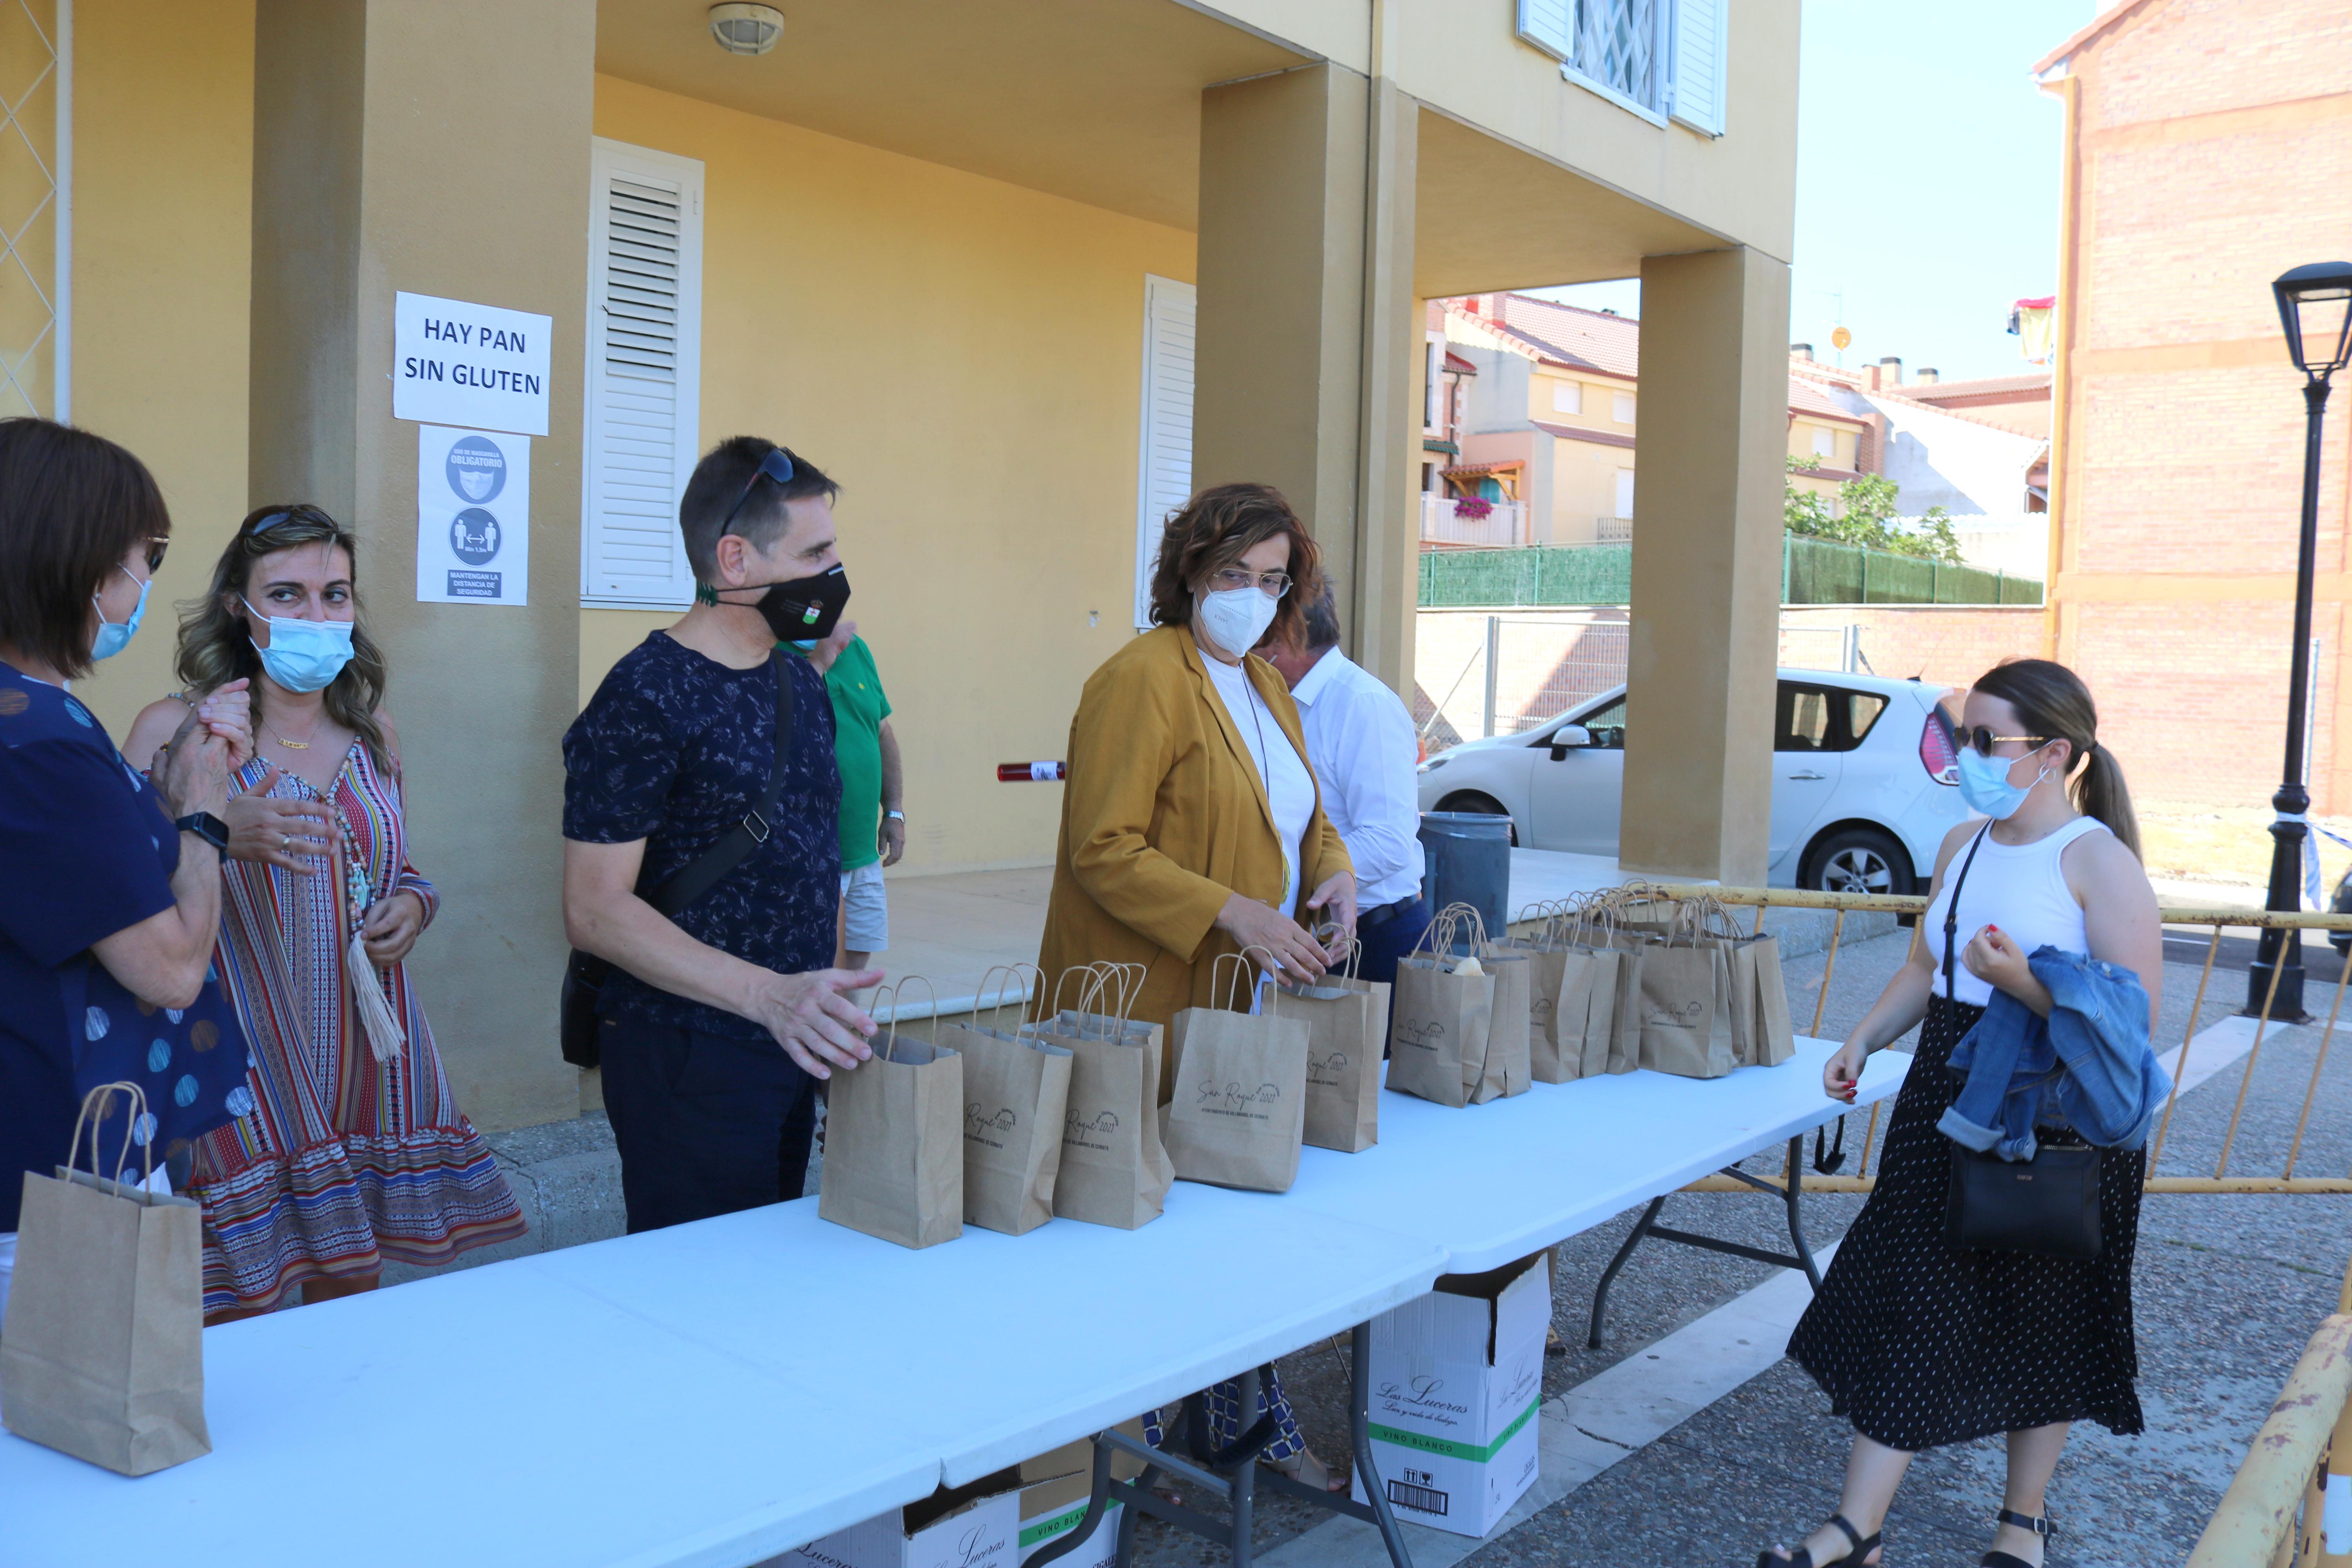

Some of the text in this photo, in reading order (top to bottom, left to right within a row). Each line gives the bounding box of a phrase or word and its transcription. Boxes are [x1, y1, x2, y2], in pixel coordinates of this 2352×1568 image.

[425, 318, 525, 353] HAY PAN
[405, 357, 539, 394] SIN GLUTEN
[451, 455, 503, 468] OBLIGATORIO
[450, 572, 489, 580] MANTENGAN
[1214, 614, 1228, 624] KN95
[1197, 1080, 1276, 1111] San Roque 2021
[964, 1103, 1012, 1136] Roque 2021
[1065, 1109, 1114, 1140] Roque 2021
[1376, 1375, 1468, 1414] Las Luceras
[1383, 1430, 1452, 1452] VINO BLANCO
[1038, 1510, 1085, 1536] VINO BLAN
[957, 1524, 1005, 1568] Luceras
[1092, 1554, 1116, 1568] CIGALE
